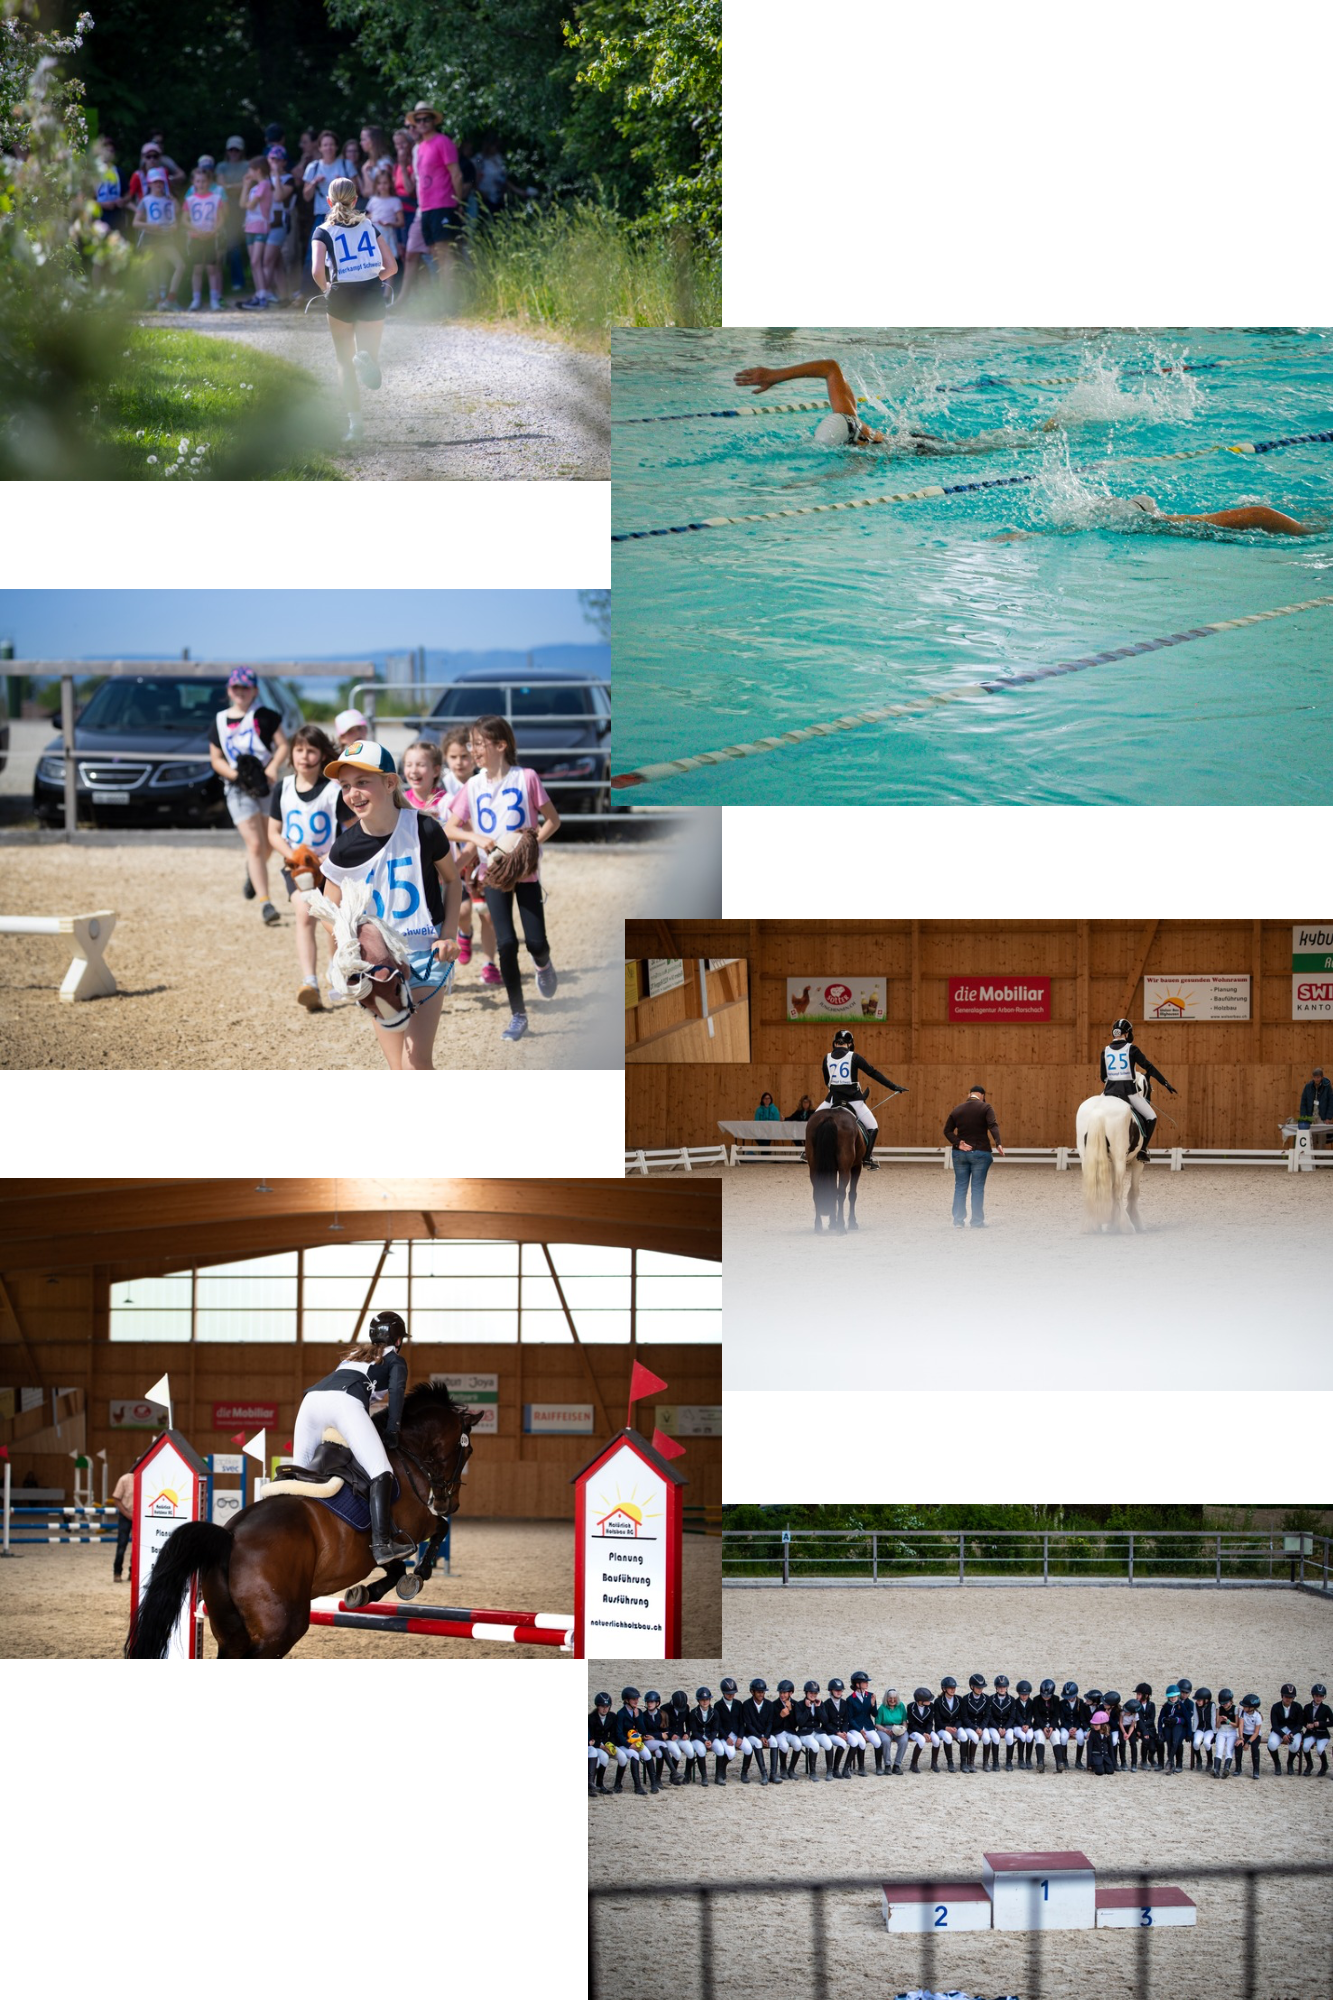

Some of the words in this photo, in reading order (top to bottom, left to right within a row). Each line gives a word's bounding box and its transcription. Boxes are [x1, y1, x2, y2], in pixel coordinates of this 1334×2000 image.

[149, 202, 173, 221] 66
[191, 202, 216, 221] 62
[335, 231, 376, 263] 14
[476, 787, 526, 834] 63
[286, 809, 332, 847] 69
[954, 986, 977, 1001] die
[980, 986, 1044, 1001] Mobiliar
[954, 1006, 996, 1014] Generalagentur
[829, 1061, 850, 1078] 26
[1107, 1053, 1128, 1070] 25
[1299, 1136, 1307, 1147] C
[216, 1406, 231, 1418] die
[232, 1406, 275, 1418] Mobiliar
[533, 1411, 591, 1421] RAIFFEISEN
[222, 1465, 239, 1473] svec
[608, 1552, 644, 1565] Planung
[602, 1573, 651, 1587] Bauführung
[602, 1594, 650, 1608] Ausführung
[590, 1619, 662, 1631] natuerlichholzbau.ch
[1040, 1879, 1050, 1901] 1
[934, 1906, 948, 1927] 2
[1139, 1907, 1153, 1927] 3
